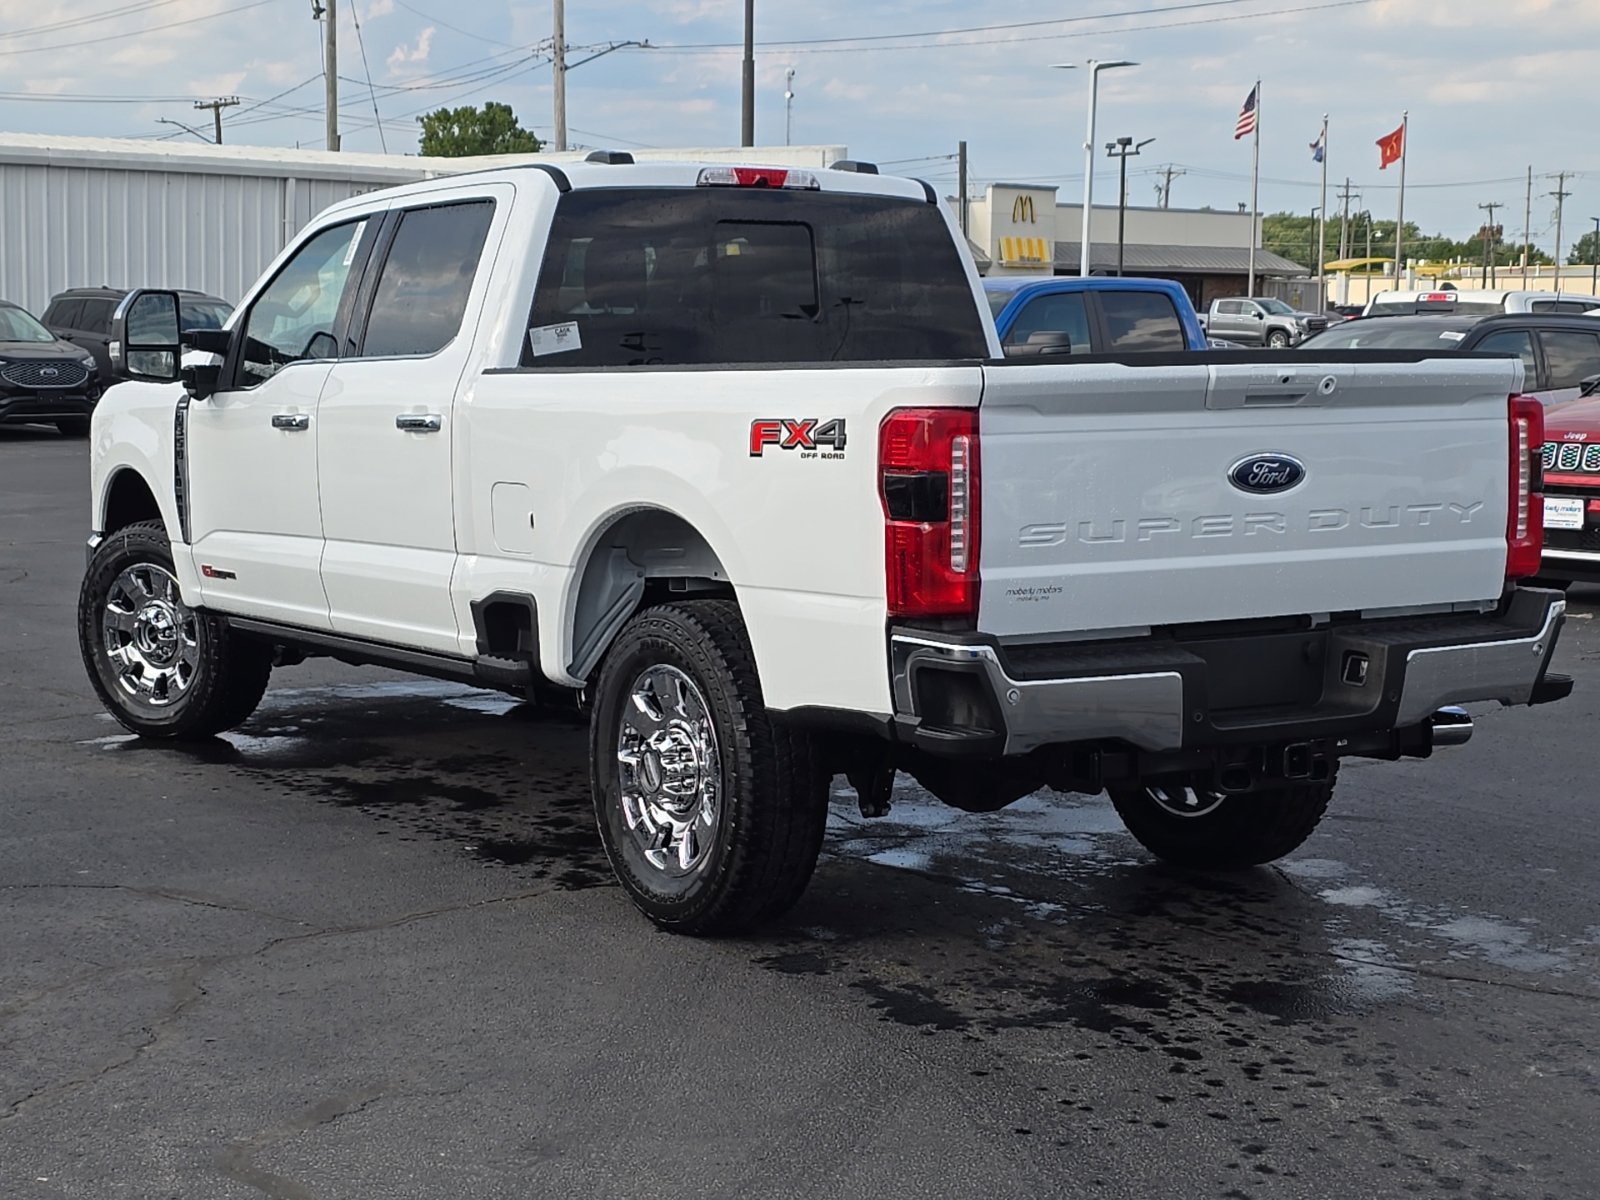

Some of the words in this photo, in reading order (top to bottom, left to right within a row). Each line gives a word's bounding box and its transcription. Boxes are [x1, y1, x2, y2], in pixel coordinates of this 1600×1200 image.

[750, 418, 847, 457] FX4
[1564, 431, 1587, 441] Jeep
[820, 452, 845, 460] ROAD
[1248, 461, 1290, 485] Ford
[1019, 512, 1286, 548] SUPER
[1308, 500, 1484, 533] DUTY
